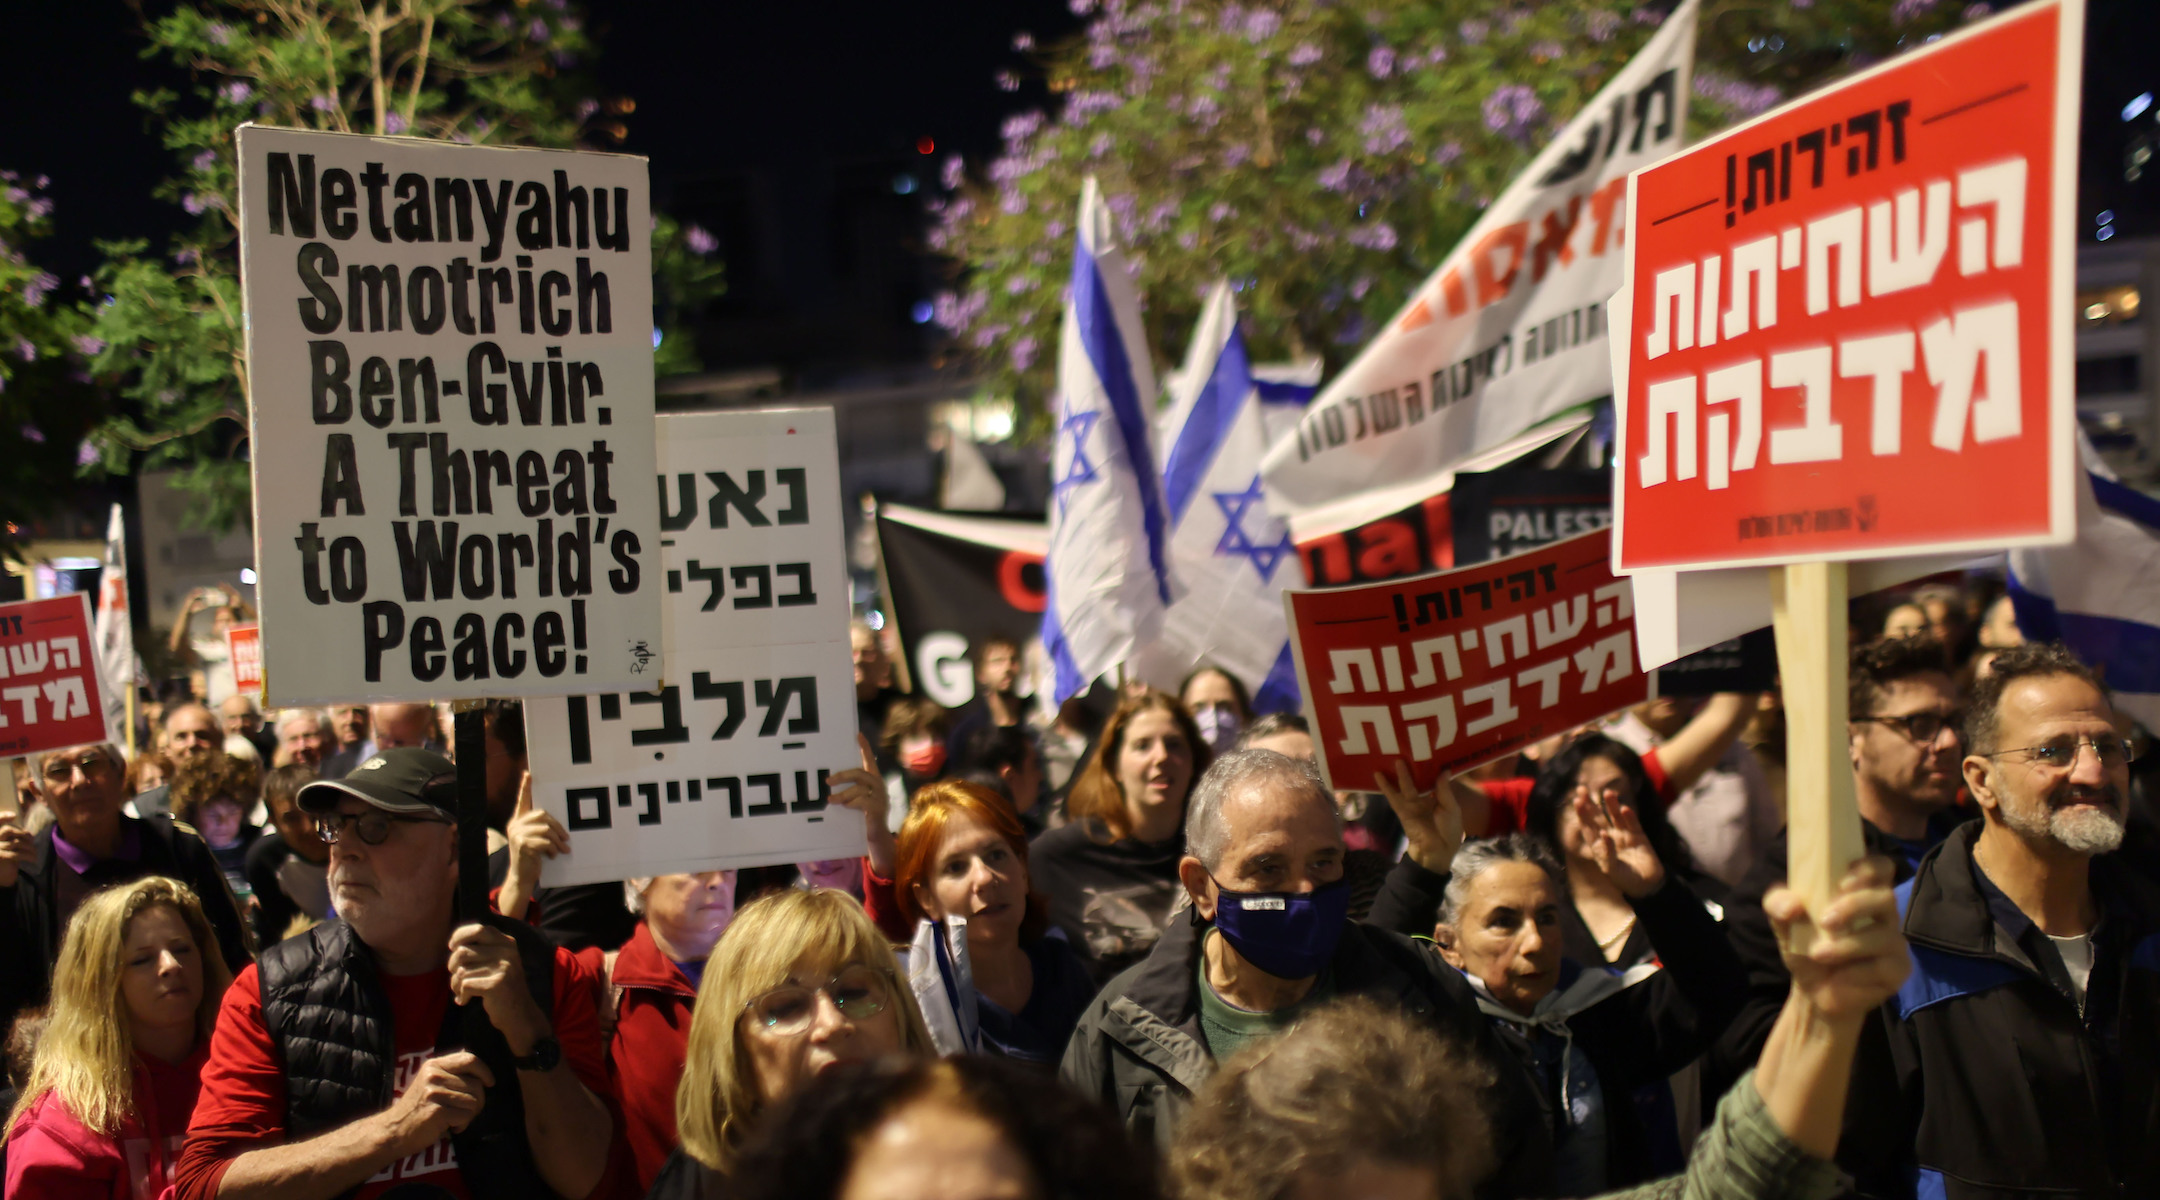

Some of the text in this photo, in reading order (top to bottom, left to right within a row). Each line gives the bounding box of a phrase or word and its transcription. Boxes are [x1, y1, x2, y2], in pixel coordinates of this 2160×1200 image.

[267, 152, 629, 263] Netanyahu
[1725, 99, 1911, 229] זהירות!
[298, 242, 612, 336] Smotrich
[1647, 157, 2028, 361] השחיתות
[308, 340, 612, 430] Ben-Gvir.
[1639, 299, 2022, 490] מדבקת
[321, 432, 617, 518] A Threat
[295, 517, 642, 603] to World's
[1490, 510, 1612, 541] PALEST
[667, 562, 817, 612] בפלי
[1393, 563, 1558, 633] זהירות!
[362, 599, 588, 683] Peace!
[1328, 579, 1634, 694] השחיתות
[1339, 630, 1633, 762] מדבקת
